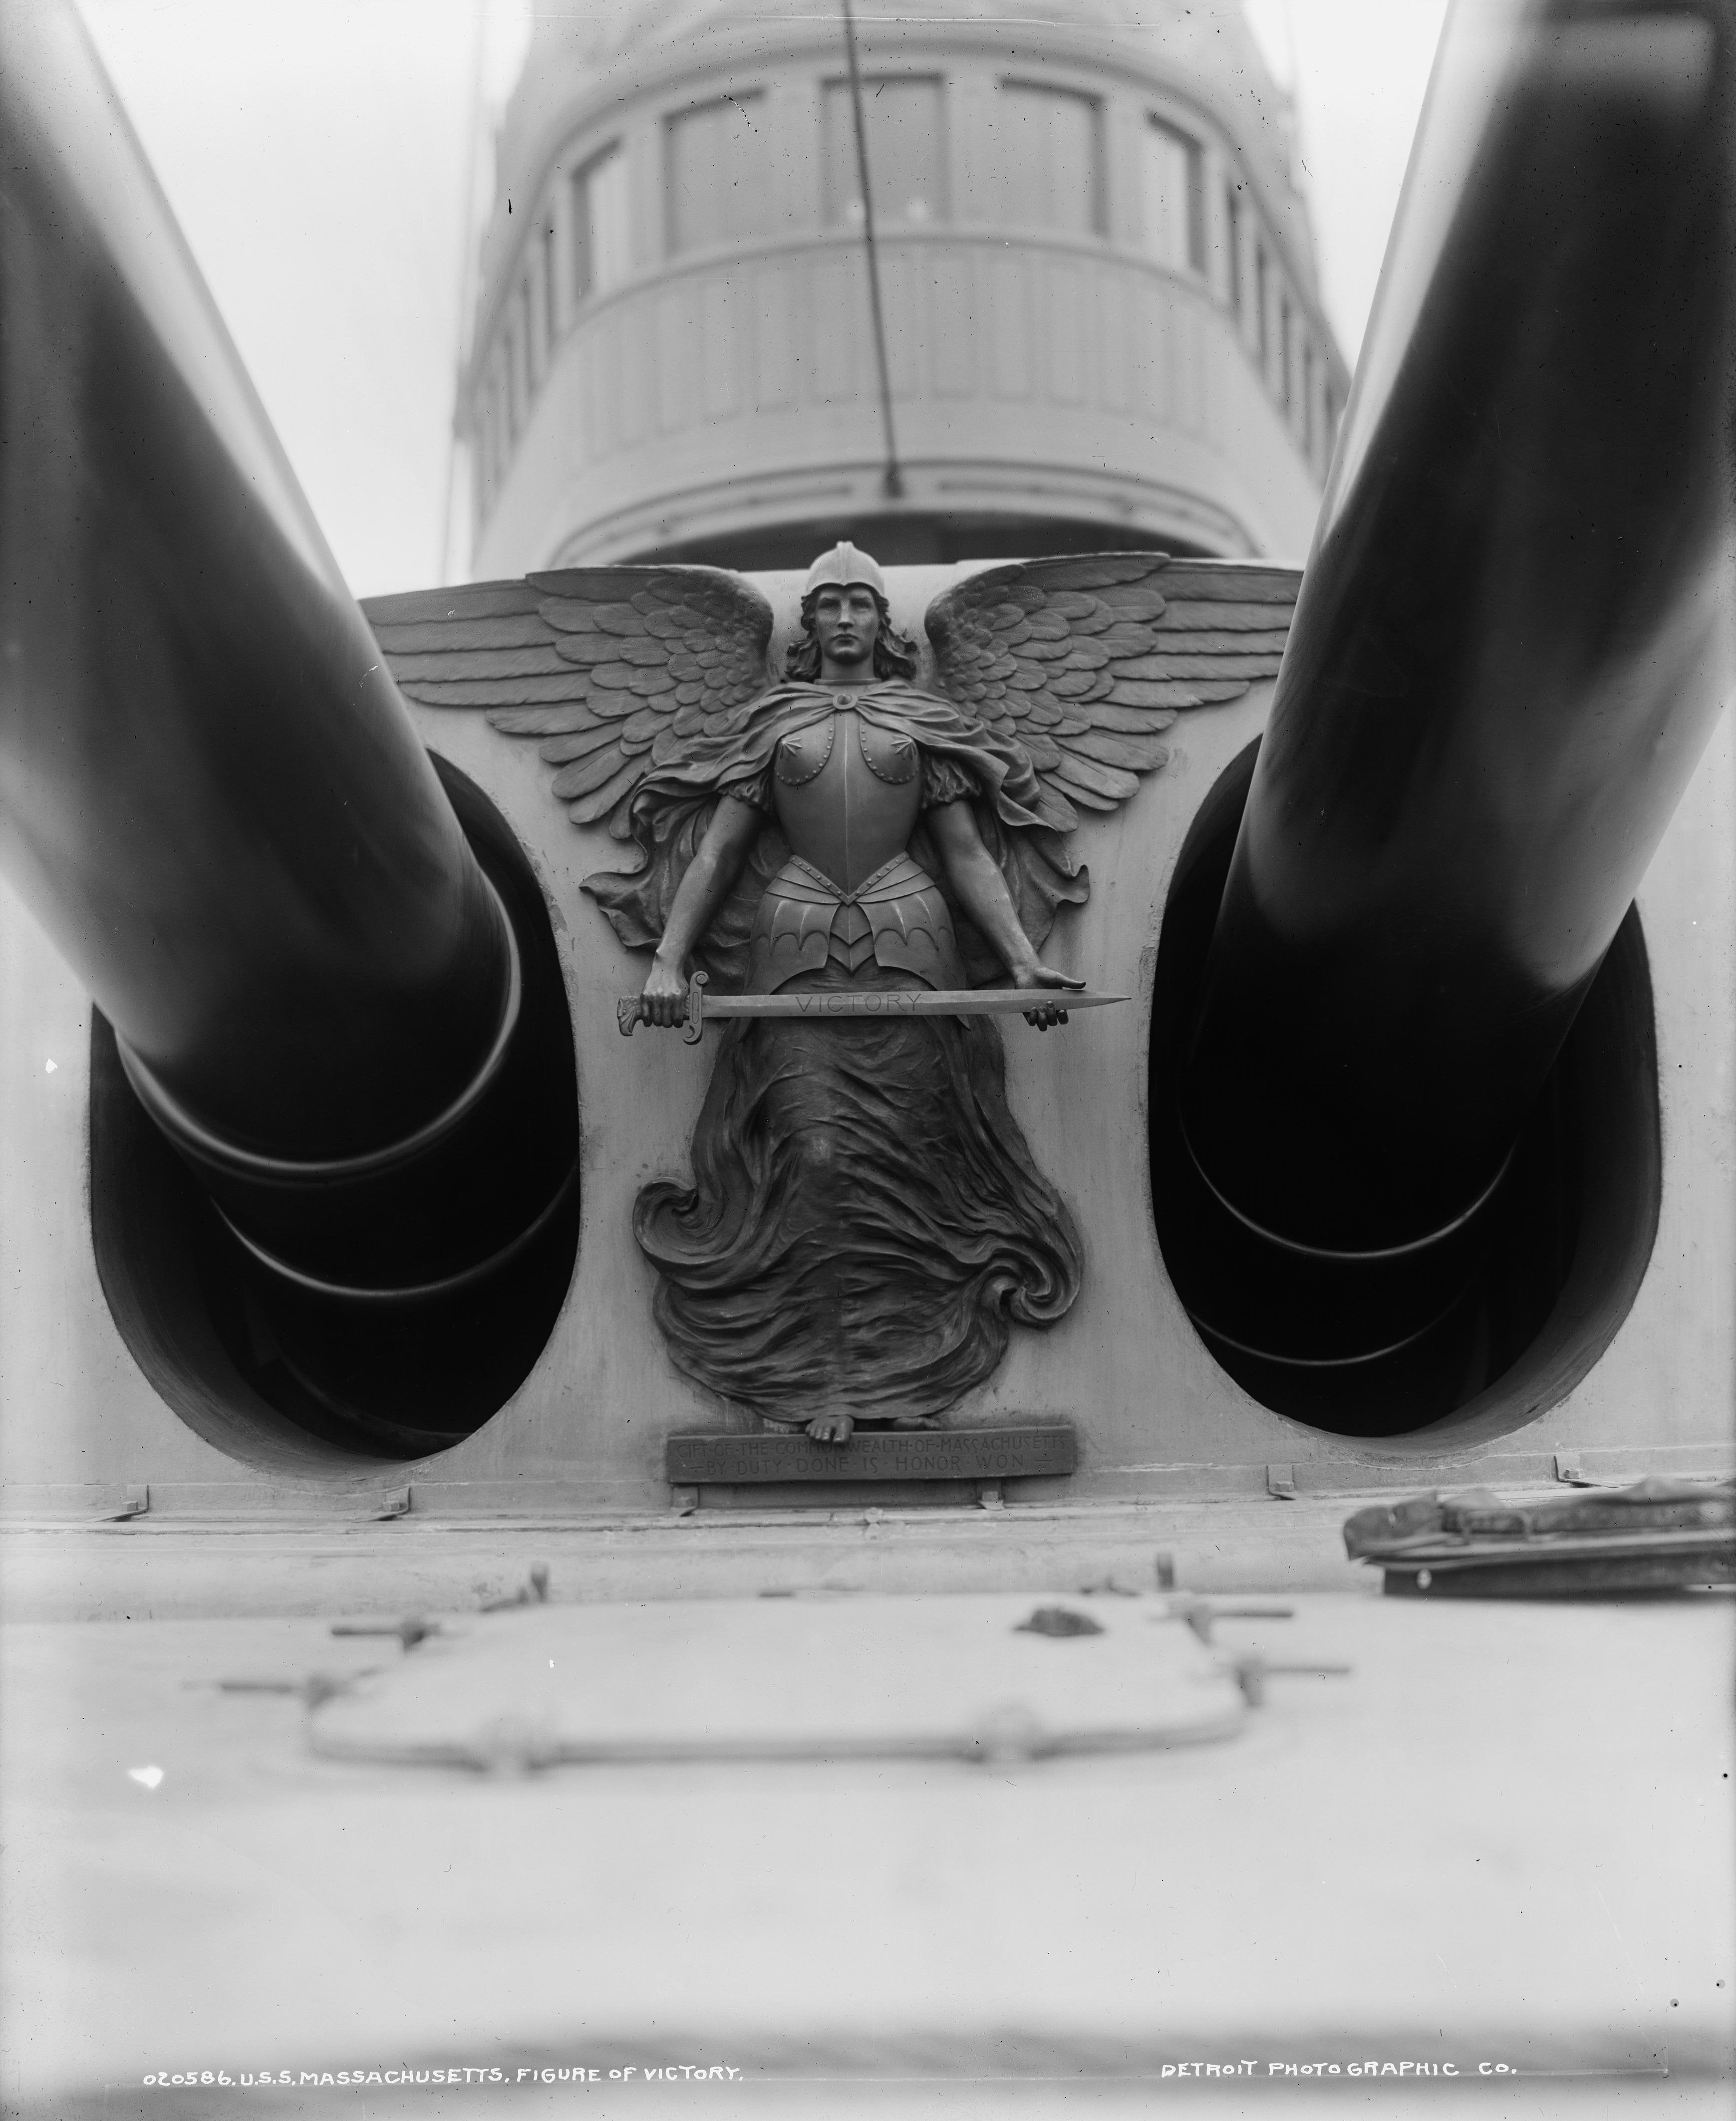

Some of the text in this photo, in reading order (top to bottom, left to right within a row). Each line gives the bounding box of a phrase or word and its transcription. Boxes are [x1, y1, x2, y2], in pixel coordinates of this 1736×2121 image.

[795, 994, 921, 1013] VICTORY
[678, 1443, 707, 1458] GIFT
[714, 1443, 734, 1457] OF
[738, 1443, 769, 1455] THE
[915, 1439, 935, 1453] OF
[940, 1435, 1068, 1453] MASSACHUSETTS
[738, 1460, 783, 1475] DUTY
[797, 1456, 850, 1473] DONE
[864, 1457, 878, 1473] IS
[896, 1455, 961, 1473] HONOR
[976, 1454, 1023, 1469] WON
